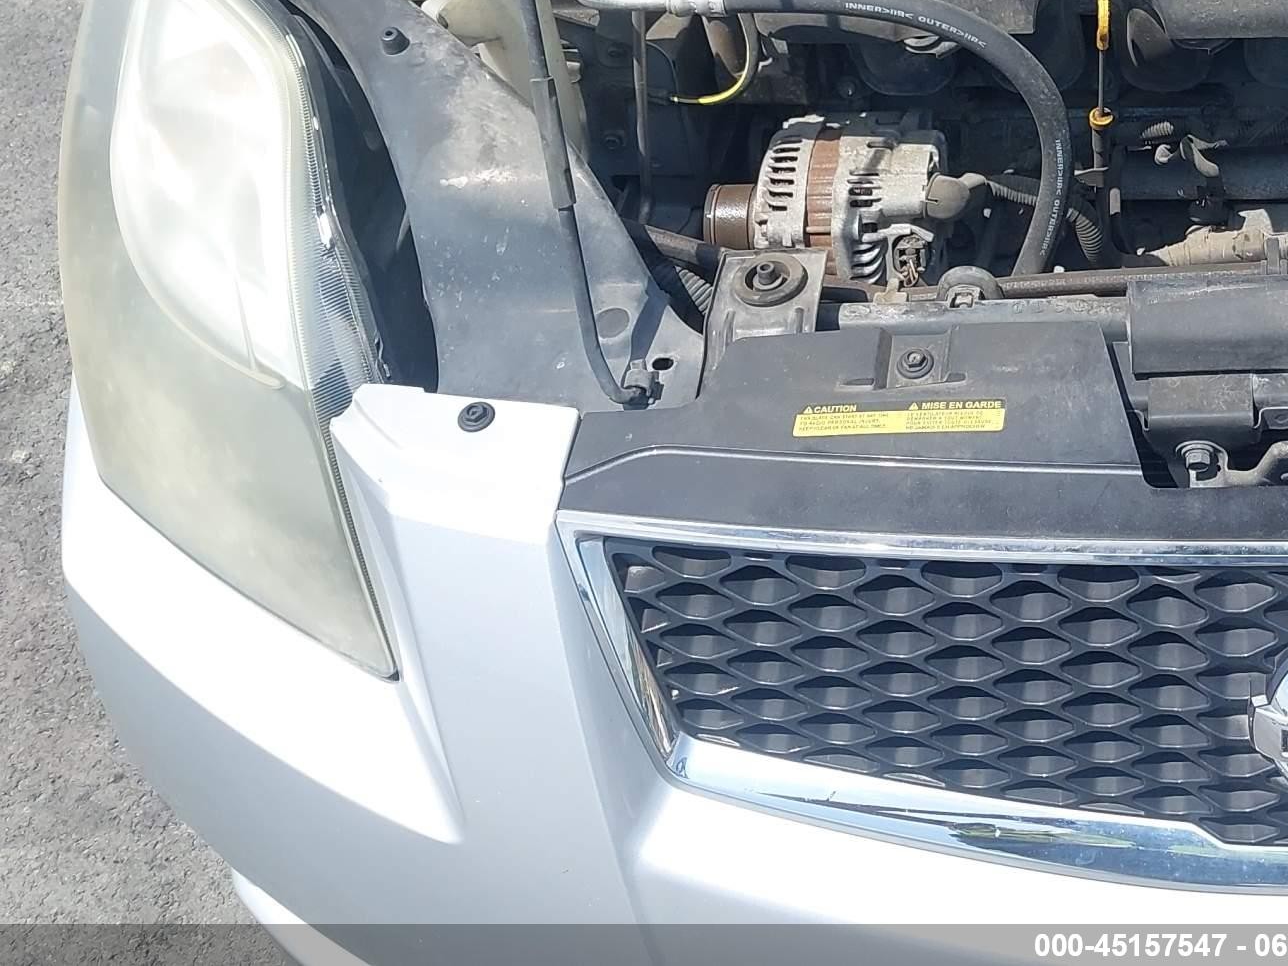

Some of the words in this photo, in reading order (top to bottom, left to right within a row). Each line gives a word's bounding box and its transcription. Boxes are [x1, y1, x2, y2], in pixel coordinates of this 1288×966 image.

[814, 404, 857, 414] CAUTION
[921, 401, 947, 410] MISE
[948, 401, 963, 409] EN
[965, 400, 1002, 409] GARDE
